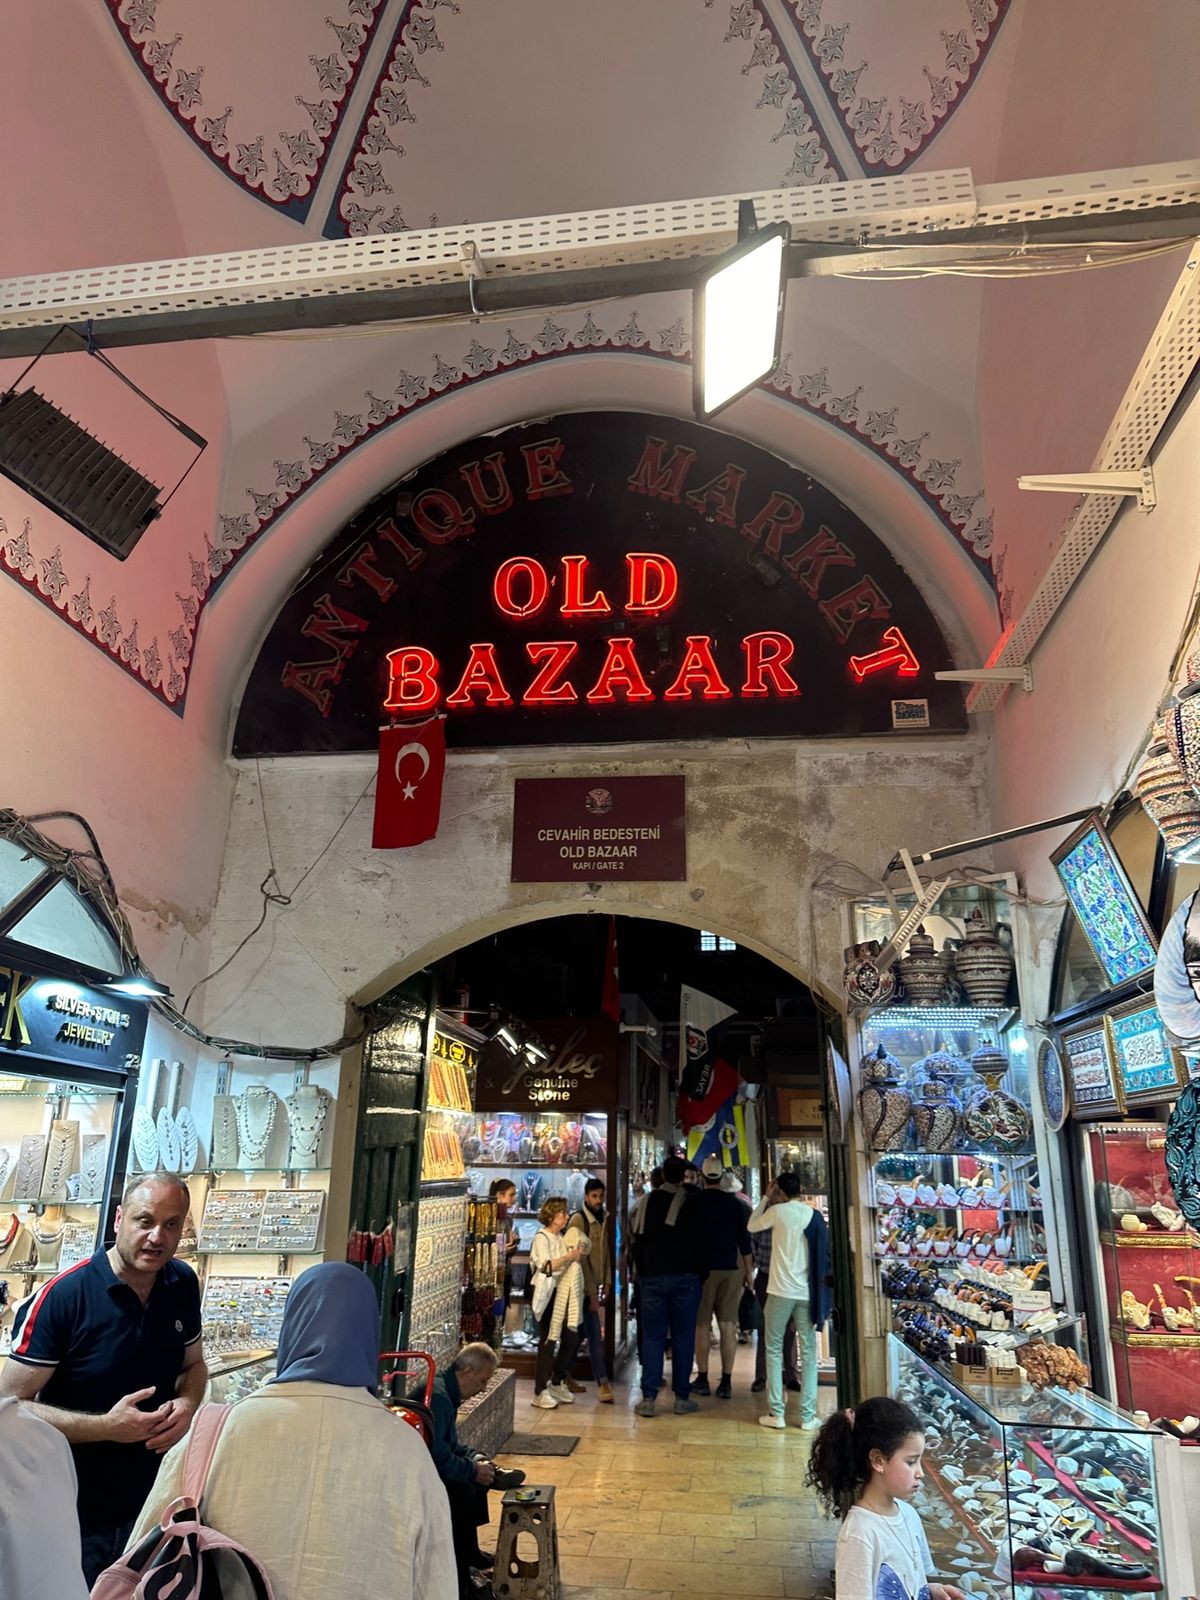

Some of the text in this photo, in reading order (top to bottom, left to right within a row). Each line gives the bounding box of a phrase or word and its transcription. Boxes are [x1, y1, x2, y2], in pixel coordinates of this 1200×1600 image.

[281, 436, 920, 717] ANTIQUE MARKET
[494, 552, 678, 616] OLD
[383, 631, 799, 710] BAZAAR
[537, 824, 661, 842] CEVAHİR BEDESTENİ
[559, 845, 638, 858] OLD BAZAAR
[572, 862, 591, 870] KAPI
[596, 861, 618, 870] GATE
[619, 861, 624, 870] 2
[0, 967, 38, 1045] K
[524, 1075, 579, 1088] Genuine
[528, 1089, 570, 1101] Stone
